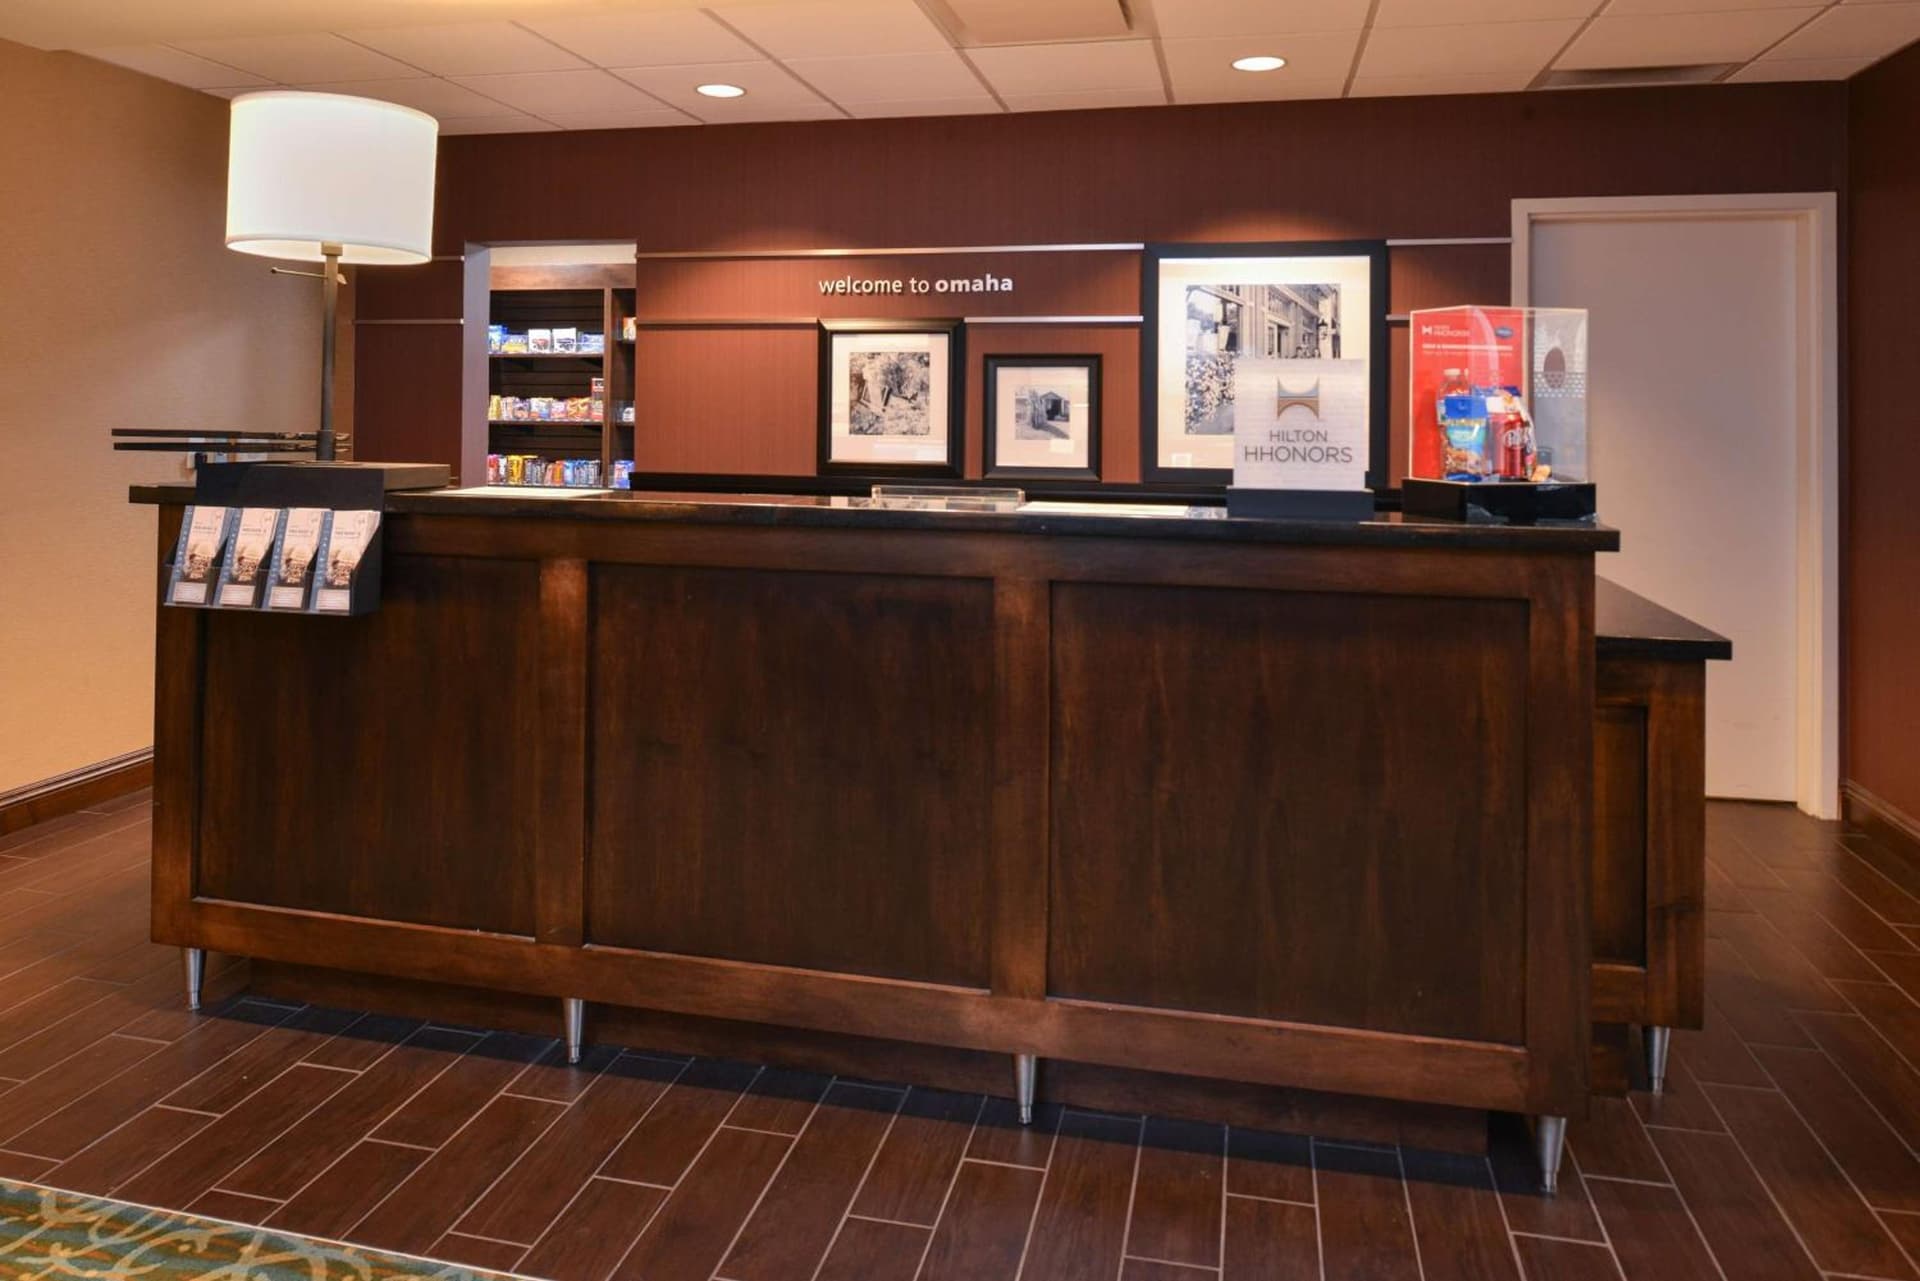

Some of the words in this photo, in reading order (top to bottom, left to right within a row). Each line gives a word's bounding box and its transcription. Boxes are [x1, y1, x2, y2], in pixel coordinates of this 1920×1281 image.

[818, 275, 903, 293] welcome
[909, 276, 930, 293] to
[935, 273, 1013, 292] omaha
[1269, 429, 1328, 442] HILTON
[1244, 445, 1353, 463] HHONORS
